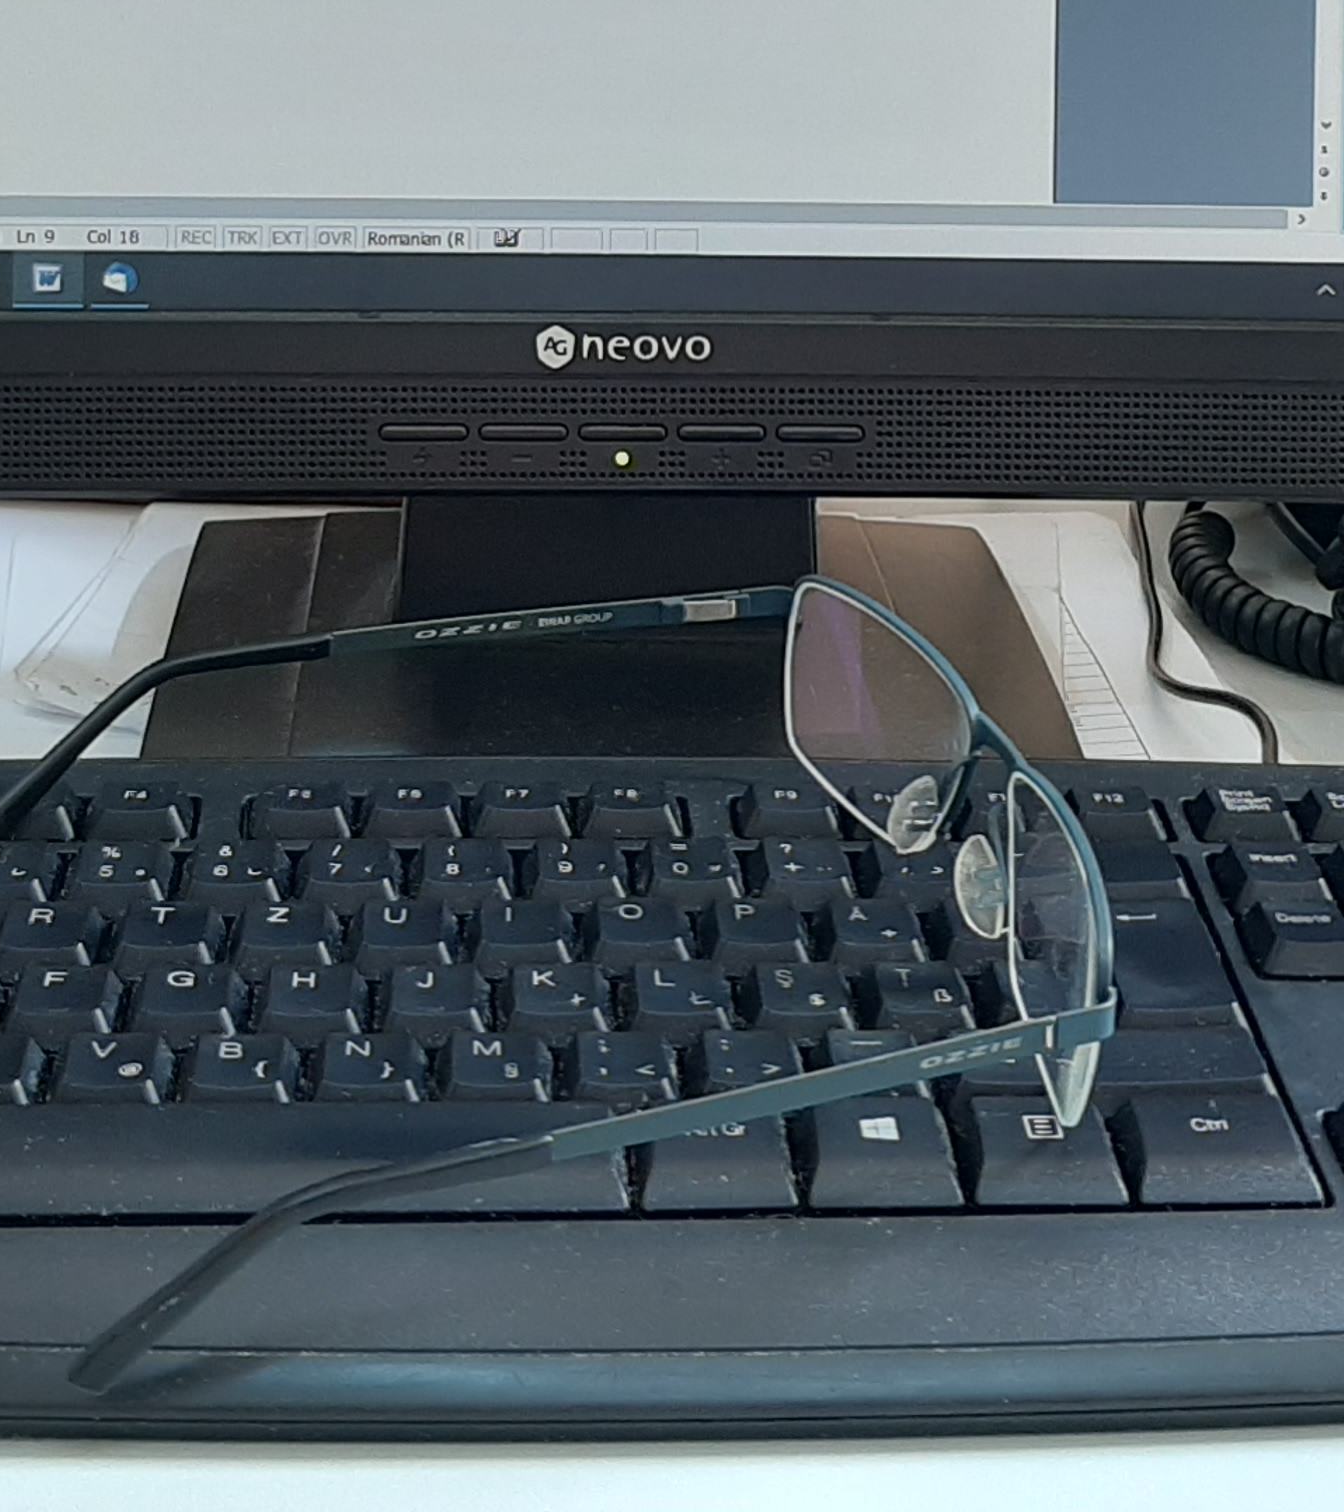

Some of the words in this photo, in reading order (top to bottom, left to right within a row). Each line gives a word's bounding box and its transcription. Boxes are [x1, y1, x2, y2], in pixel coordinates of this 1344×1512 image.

[16, 229, 40, 244] Ln
[86, 229, 112, 245] Col
[119, 230, 140, 245] 18
[181, 230, 212, 246] REC
[227, 230, 258, 246] TRK
[271, 230, 303, 246] EXT
[317, 230, 353, 246] OVR
[367, 230, 442, 247] Romanian
[581, 332, 713, 361] neovo
[414, 619, 523, 639] OZZIE
